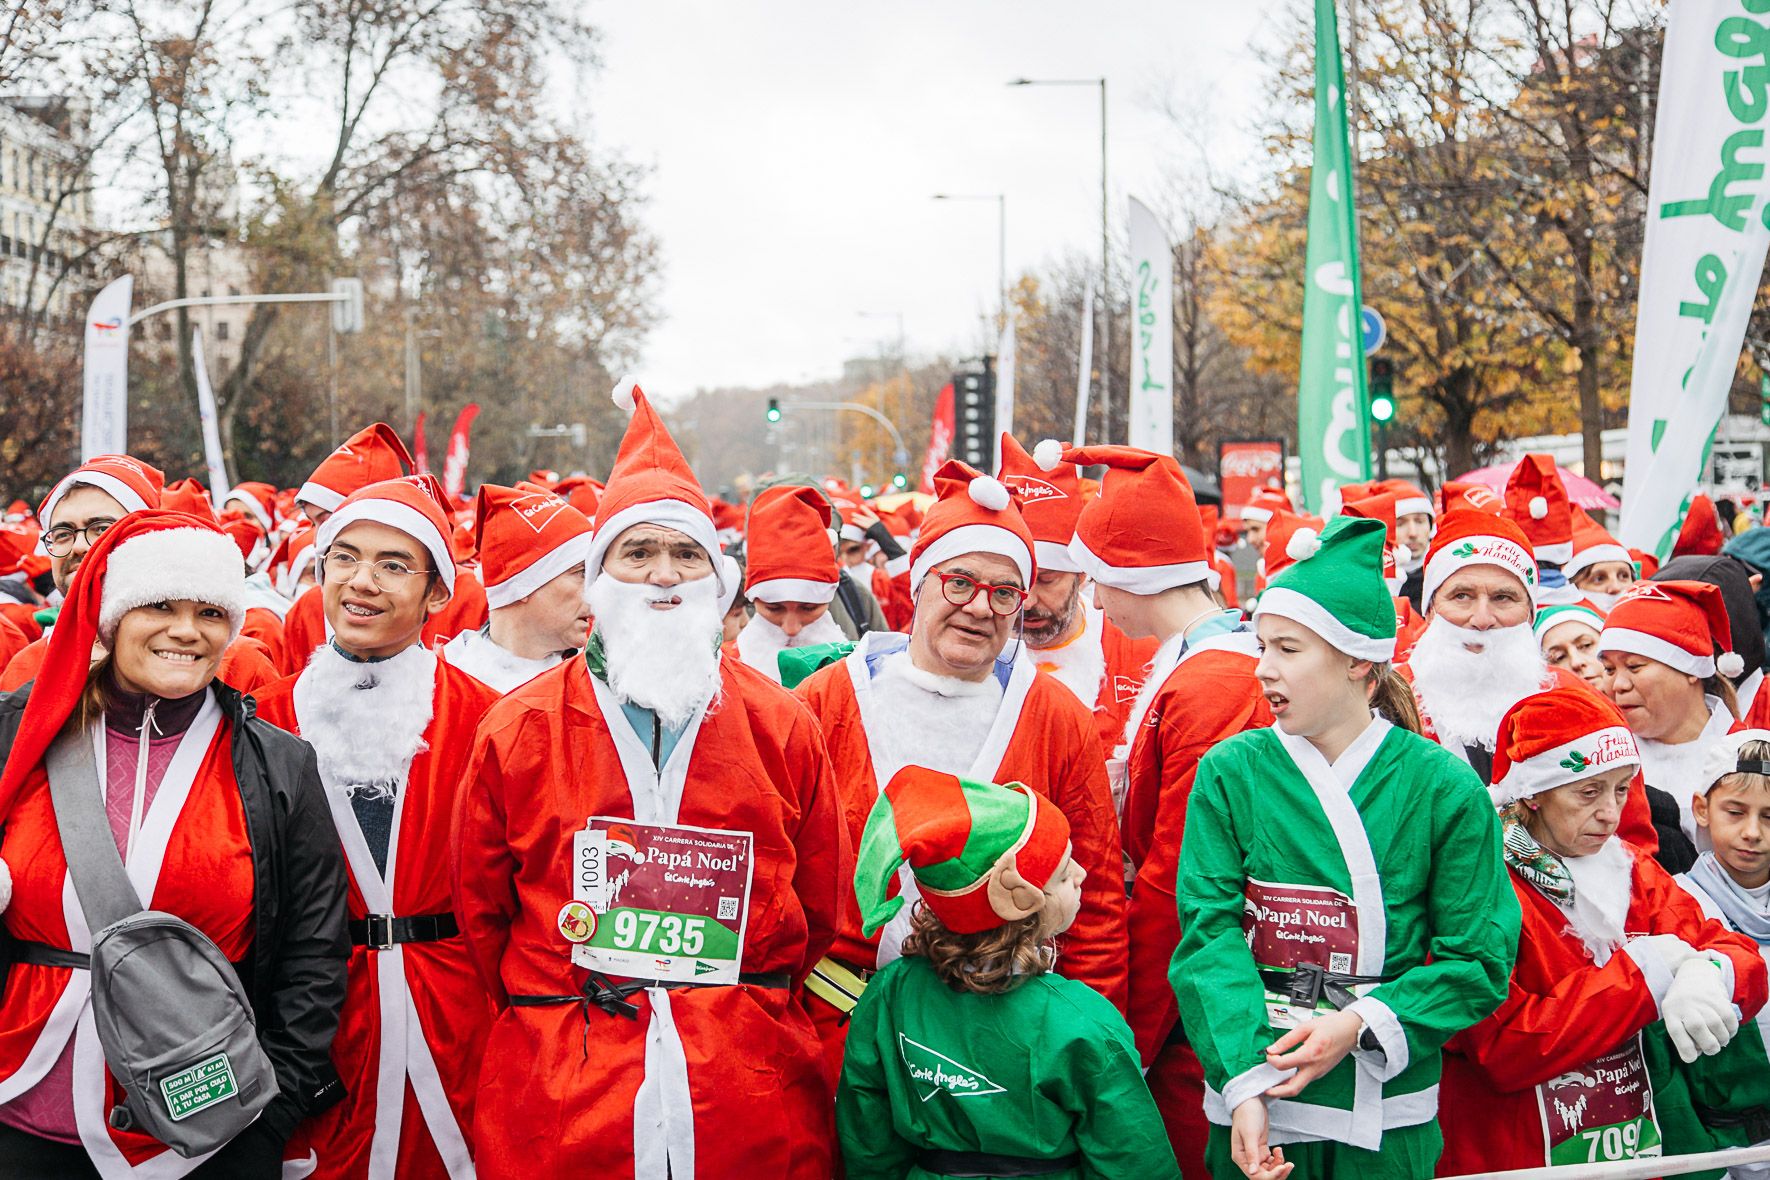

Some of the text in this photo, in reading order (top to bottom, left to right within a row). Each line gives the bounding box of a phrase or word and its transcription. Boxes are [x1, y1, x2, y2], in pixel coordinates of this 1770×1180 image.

[664, 836, 693, 846] CARRERA
[694, 840, 726, 849] SOLIDARIA
[582, 846, 599, 892] 1003
[646, 847, 738, 872] Papá Noel
[1273, 896, 1301, 904] CARRERA
[1302, 898, 1333, 906] SOLIDARIA
[1261, 905, 1347, 929] Papá Noel
[613, 910, 706, 956] 9735
[168, 1078, 183, 1090] 500
[184, 1074, 192, 1084] M
[1594, 1062, 1629, 1085] Papá
[173, 1075, 228, 1105] A DAR POR CULO
[175, 1091, 212, 1113] A TU CASA
[1582, 1118, 1642, 1163] 709
